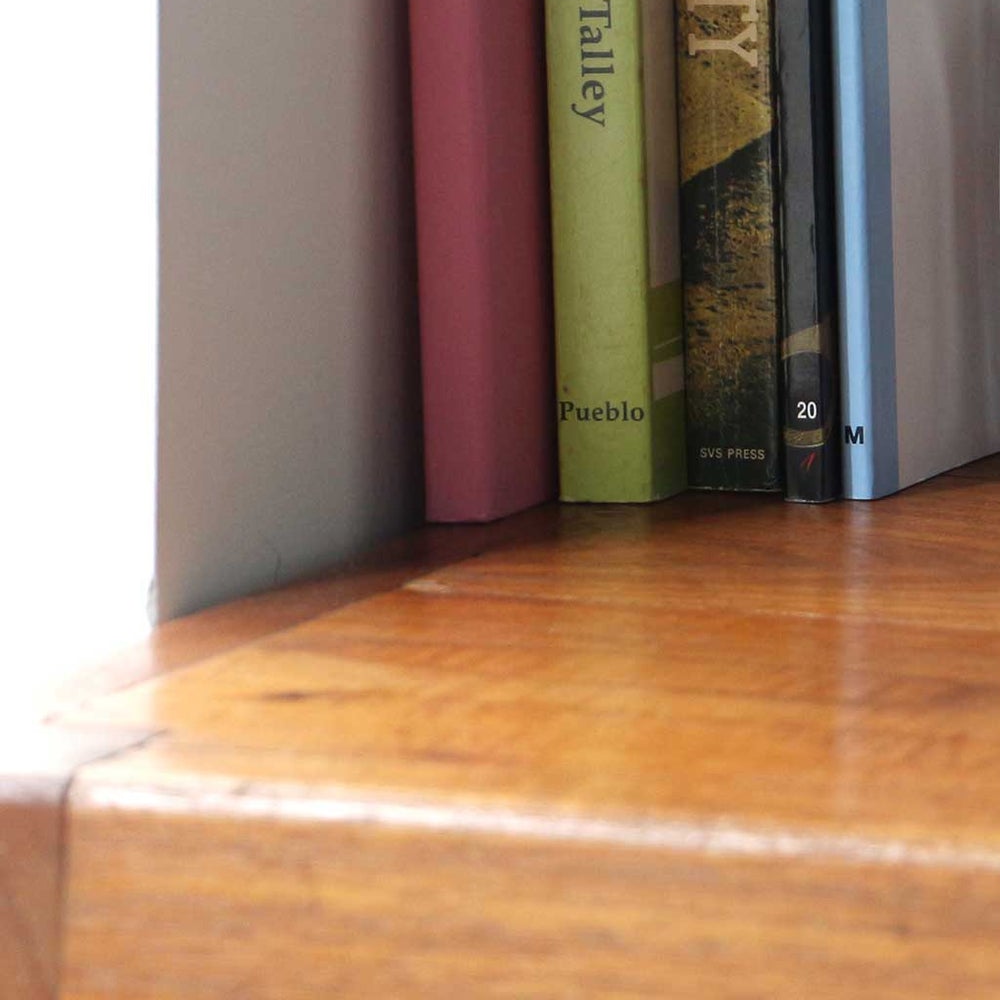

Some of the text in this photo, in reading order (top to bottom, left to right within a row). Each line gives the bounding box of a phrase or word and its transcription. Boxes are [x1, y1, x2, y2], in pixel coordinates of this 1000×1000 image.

[571, 0, 615, 128] Talley
[559, 401, 645, 423] Pueblo
[796, 401, 818, 420] 20
[844, 425, 865, 445] M
[700, 447, 766, 461] SVS PRESS
